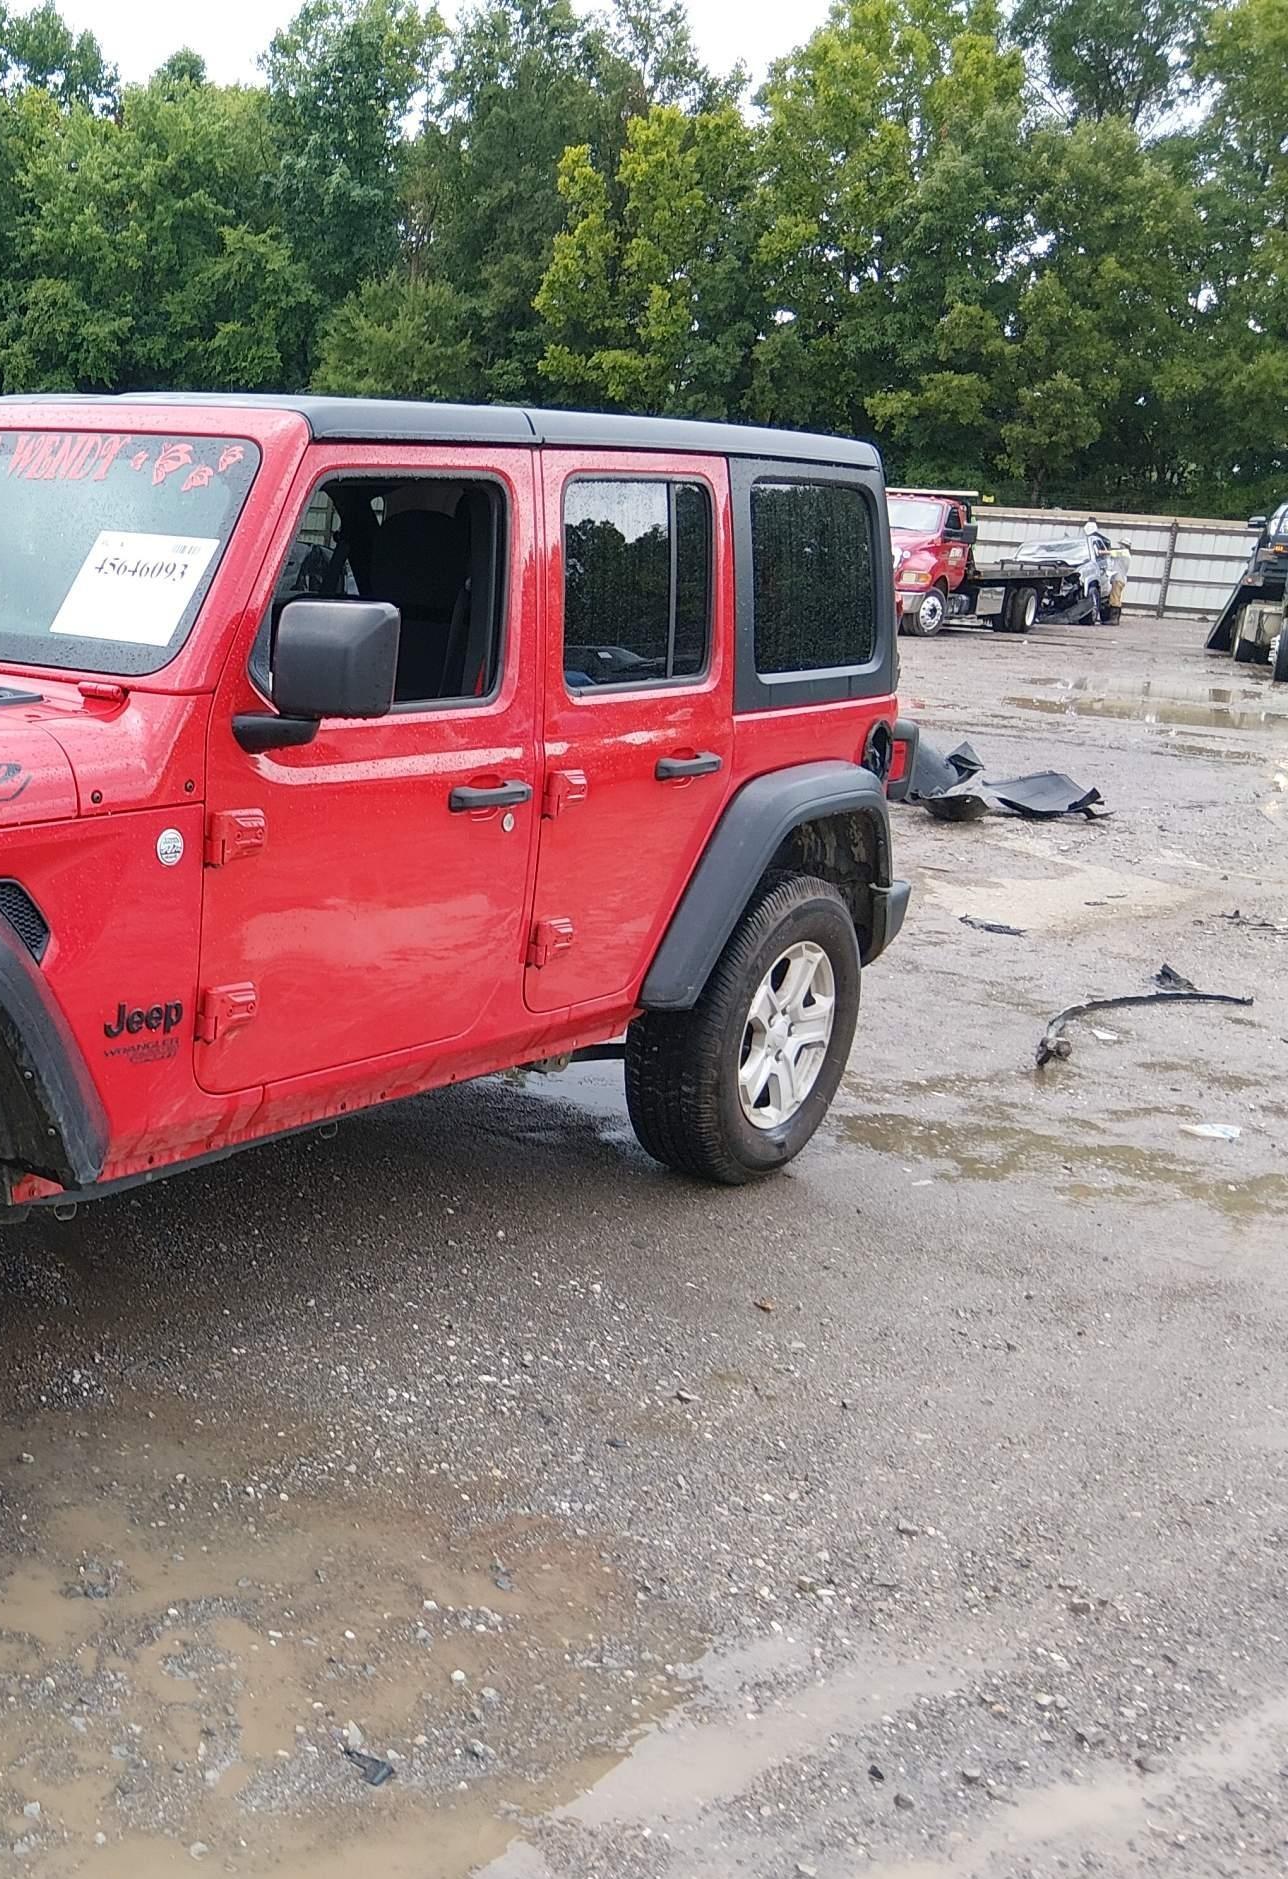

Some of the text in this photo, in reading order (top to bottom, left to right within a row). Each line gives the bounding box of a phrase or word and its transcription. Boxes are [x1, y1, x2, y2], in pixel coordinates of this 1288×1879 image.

[7, 434, 133, 482] WENDY
[94, 557, 189, 581] 45646093
[103, 1001, 183, 1038] Jeep
